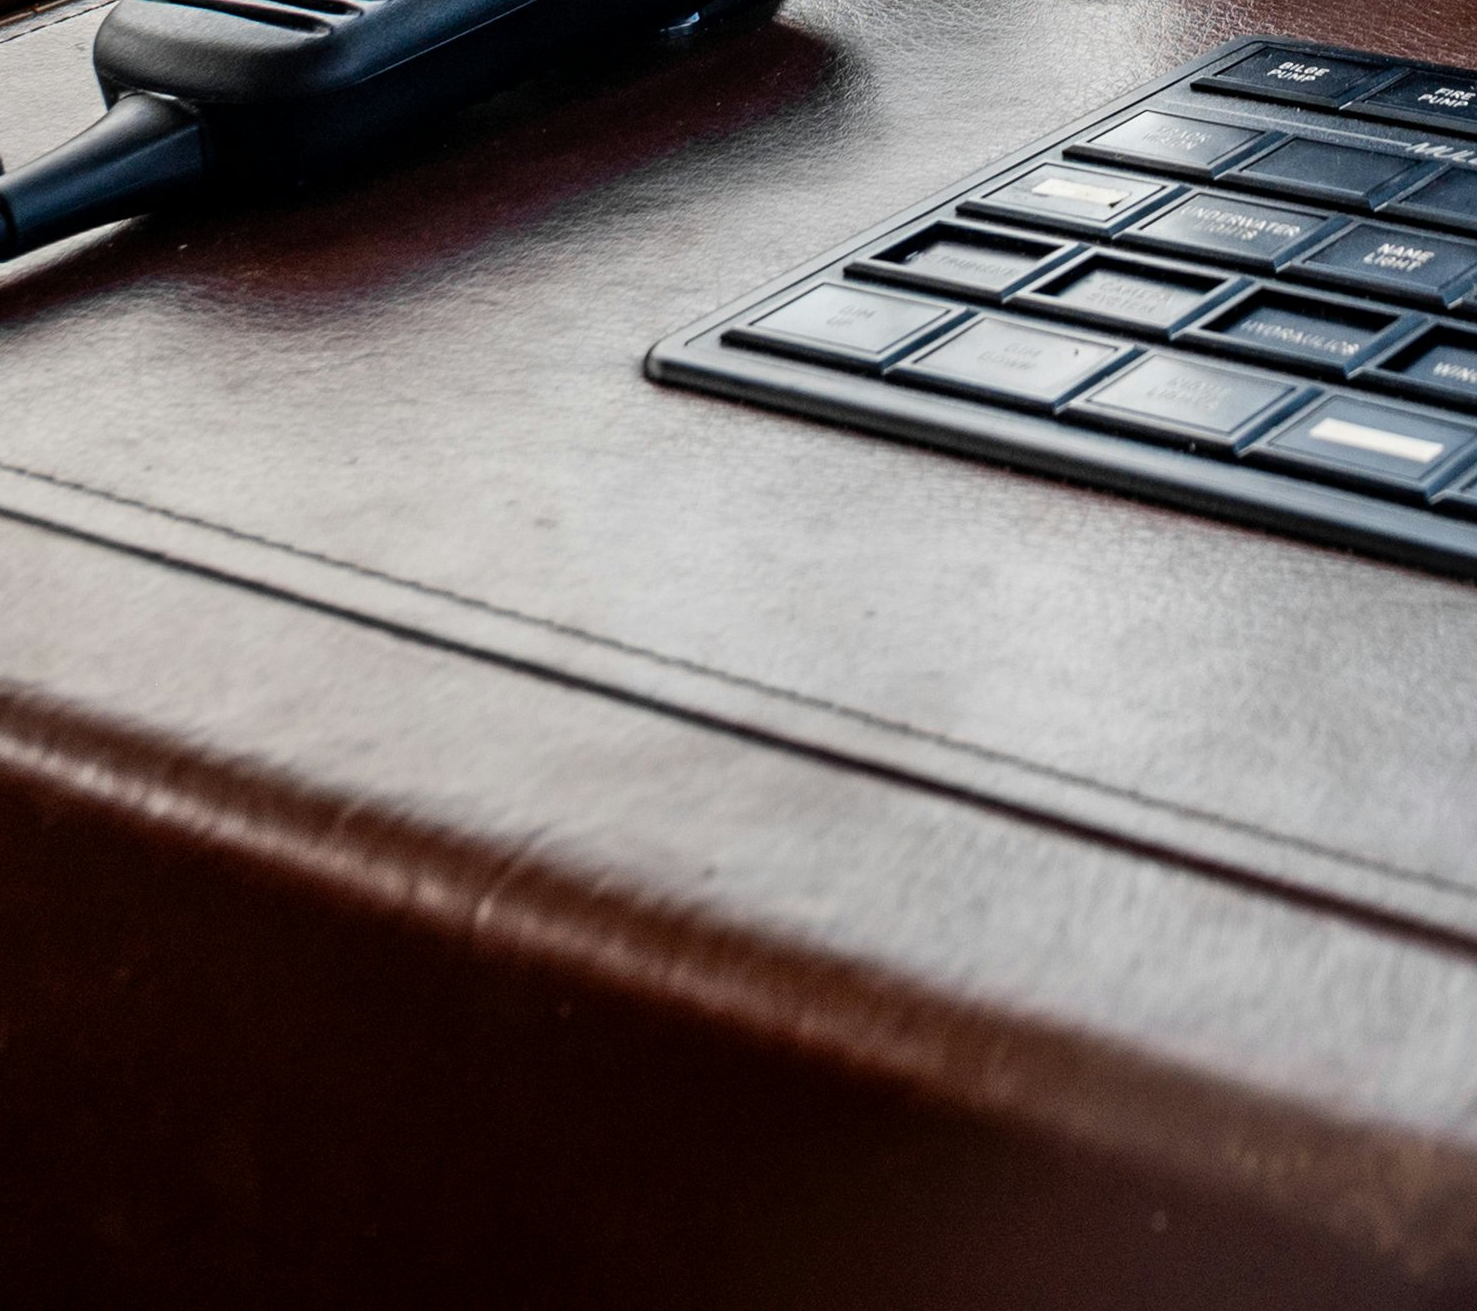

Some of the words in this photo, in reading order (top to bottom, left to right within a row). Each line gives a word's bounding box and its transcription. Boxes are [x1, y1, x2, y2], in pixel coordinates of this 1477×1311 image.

[1267, 68, 1318, 83] PUMP
[1278, 61, 1330, 78] BILGE
[1418, 92, 1470, 109] PUMP
[1434, 87, 1476, 102] FIRE
[1181, 205, 1302, 238] UNDERWATER
[1363, 250, 1423, 272] LIGHT
[1378, 242, 1436, 263] NAME
[1239, 319, 1362, 357] HYDRAULICS
